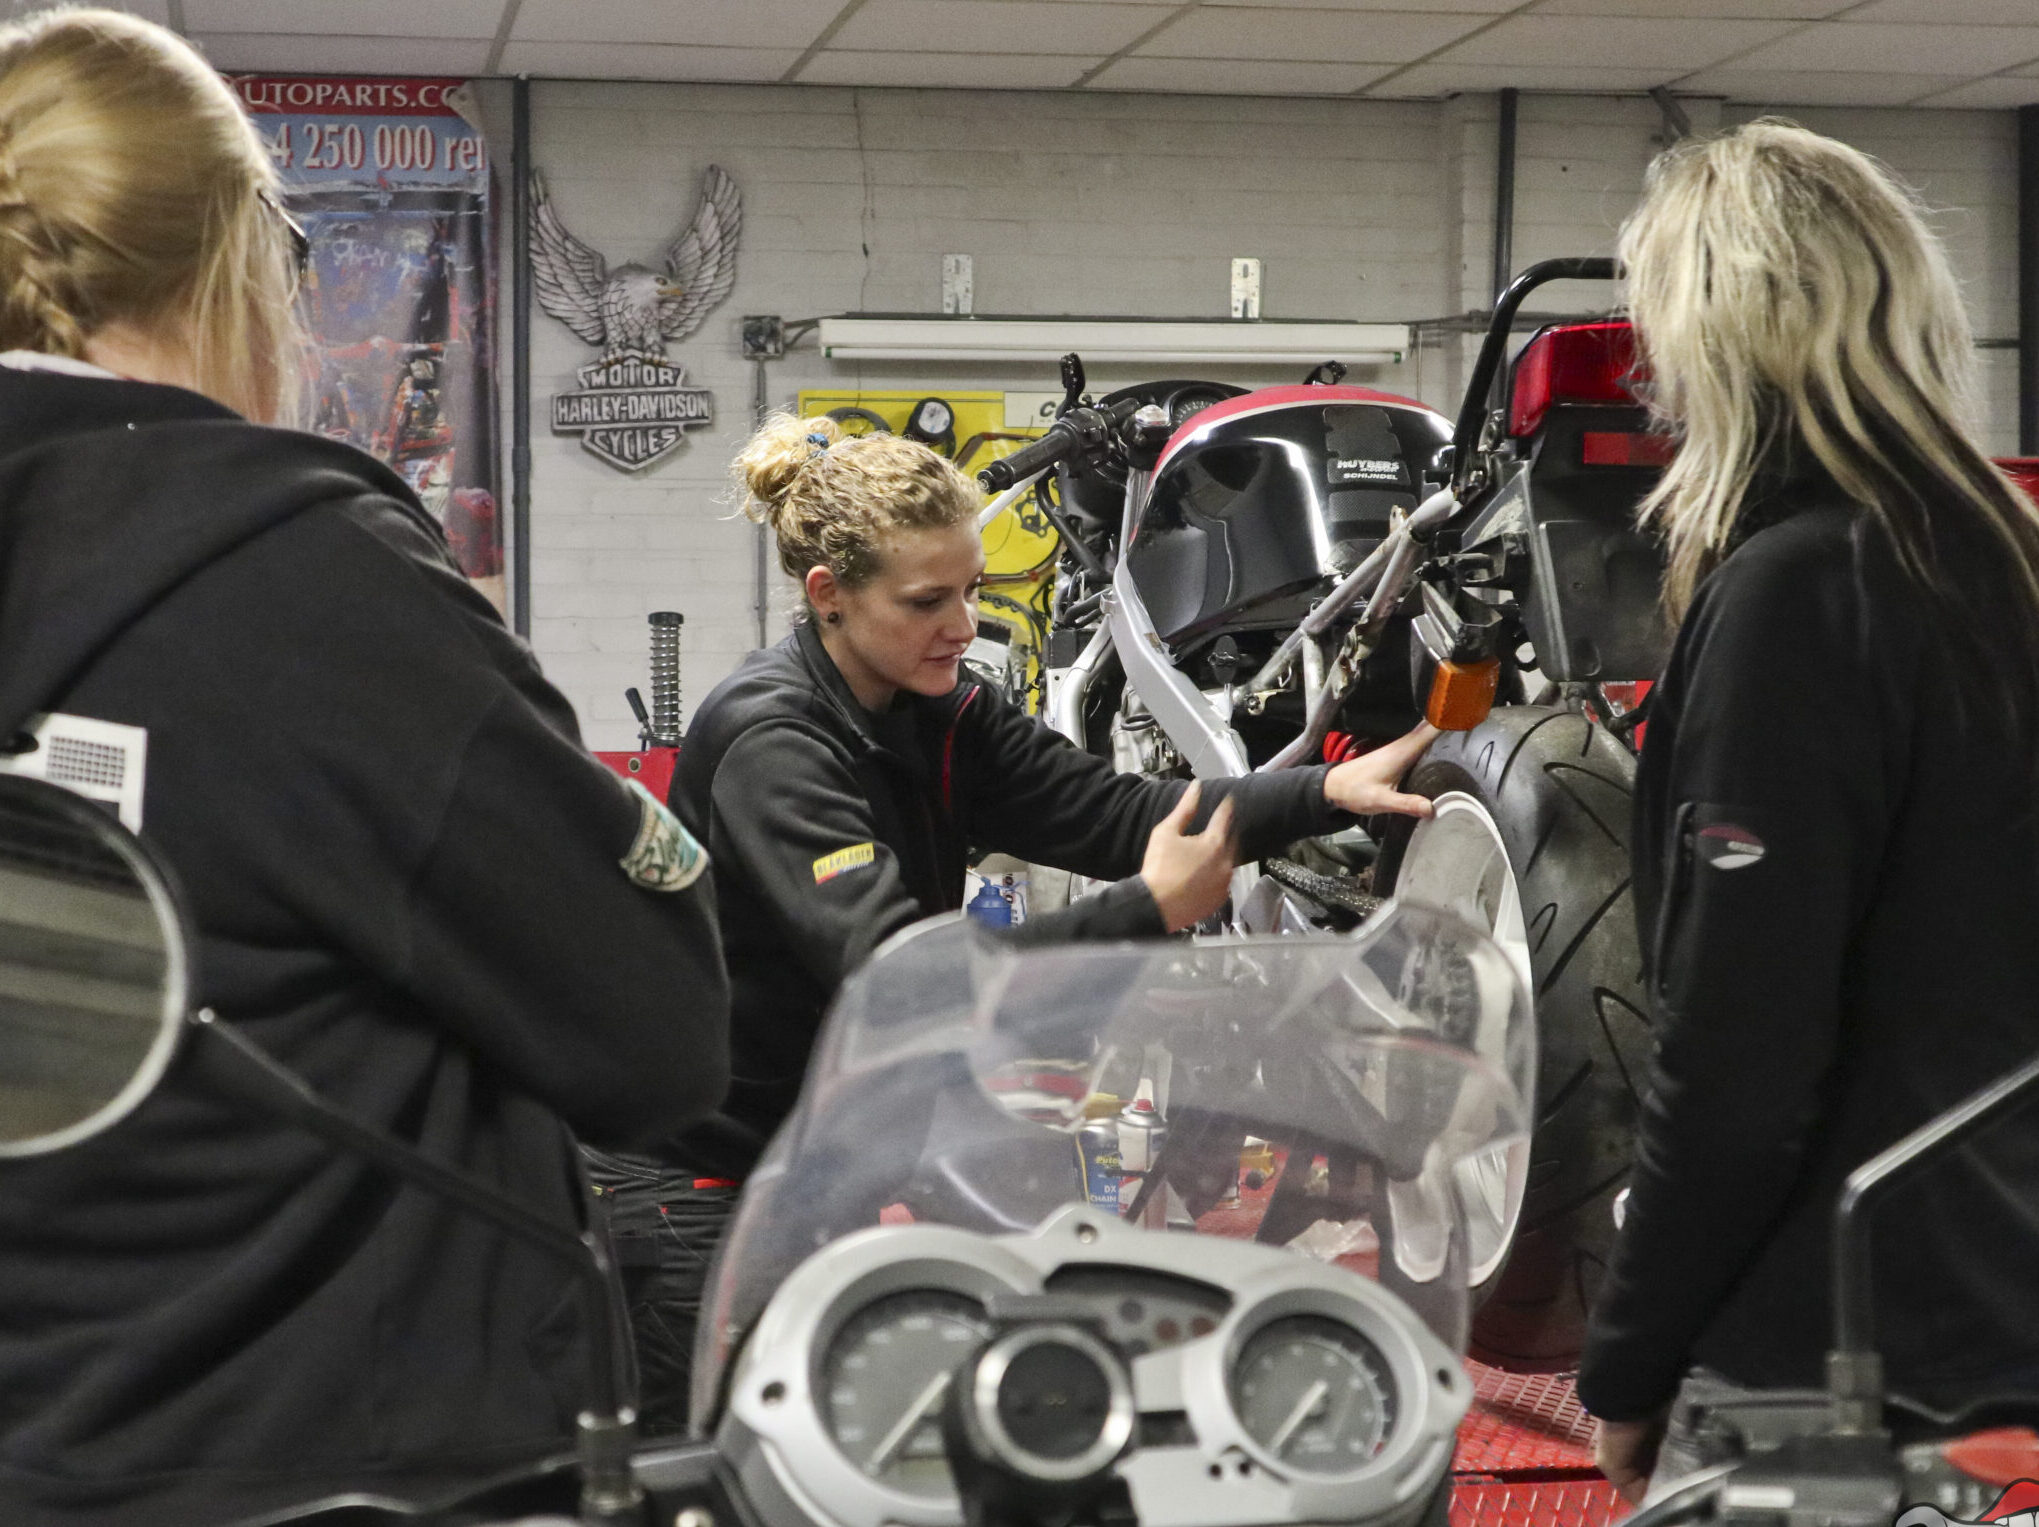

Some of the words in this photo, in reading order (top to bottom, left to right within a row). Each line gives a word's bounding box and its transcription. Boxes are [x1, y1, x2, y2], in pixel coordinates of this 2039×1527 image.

[241, 82, 458, 108] UTOPARTS.CO
[303, 122, 365, 170] 250
[374, 124, 435, 171] 000
[590, 359, 675, 387] MOTOR
[557, 393, 709, 423] HARLEY-DAVIDSON
[594, 427, 677, 461] CYCLES
[1343, 472, 1399, 480] SCHIJNDEL
[1090, 1194, 1117, 1203] CHAIN
[1104, 1184, 1117, 1193] DX
